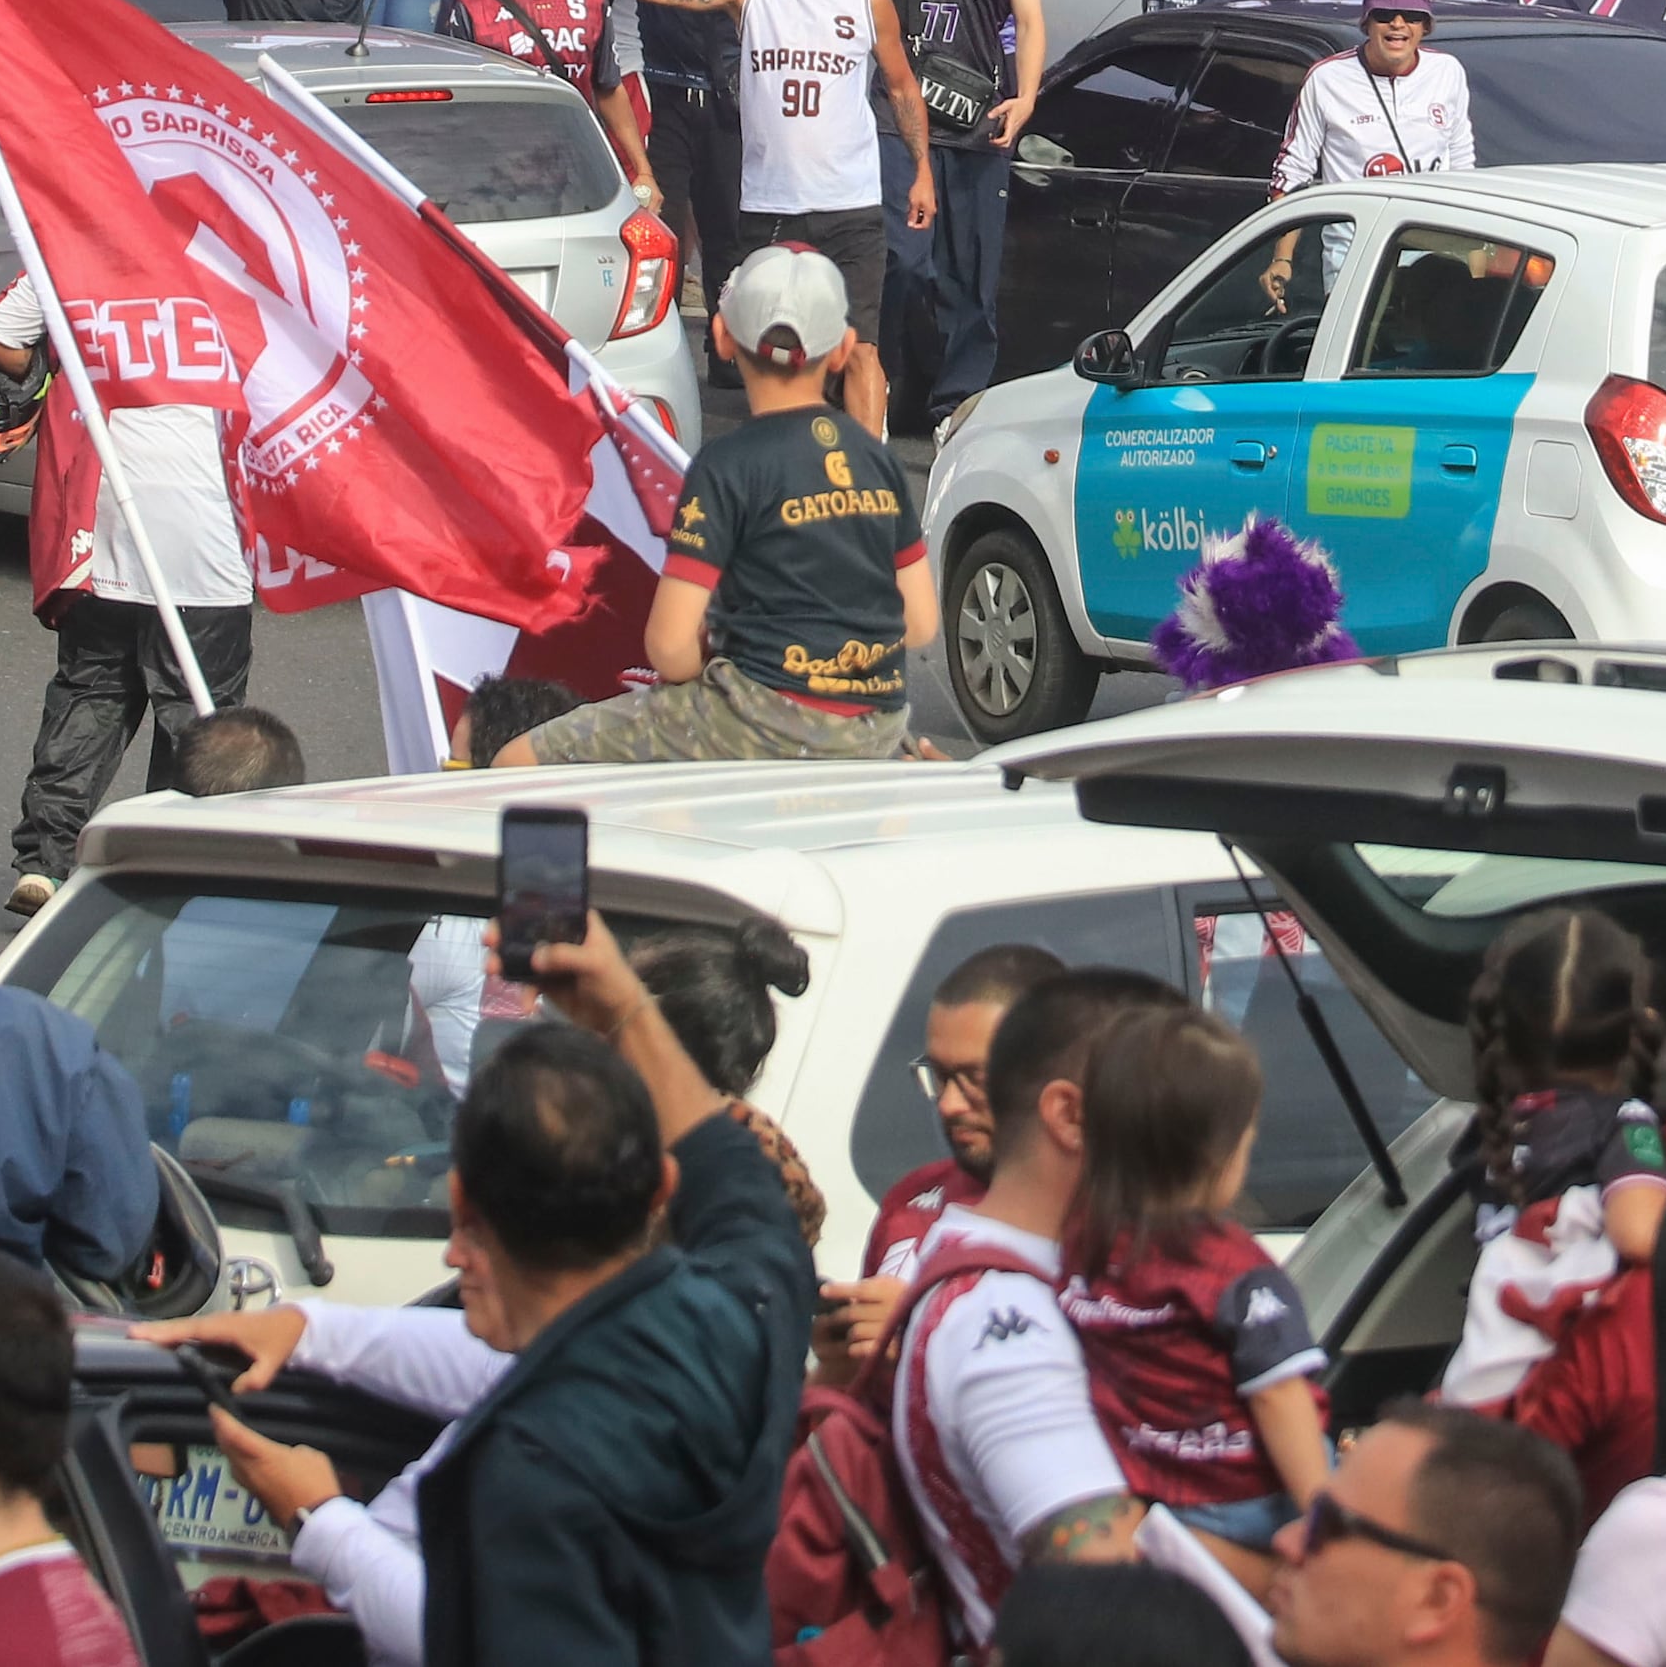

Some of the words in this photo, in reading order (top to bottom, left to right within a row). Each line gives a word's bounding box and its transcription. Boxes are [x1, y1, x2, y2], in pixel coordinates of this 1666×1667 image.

[833, 15, 856, 40] S
[920, 1, 960, 43] 77
[782, 79, 821, 118] 90
[920, 76, 982, 123] VLTN
[141, 109, 276, 187] SAPRISSA
[296, 401, 349, 443] RICA
[1105, 428, 1215, 447] COMERCIALIZADOR
[1120, 449, 1195, 467] AUTORIZADO
[1141, 506, 1204, 550] kölbi
[163, 1520, 281, 1548] CENTROAMERICA
